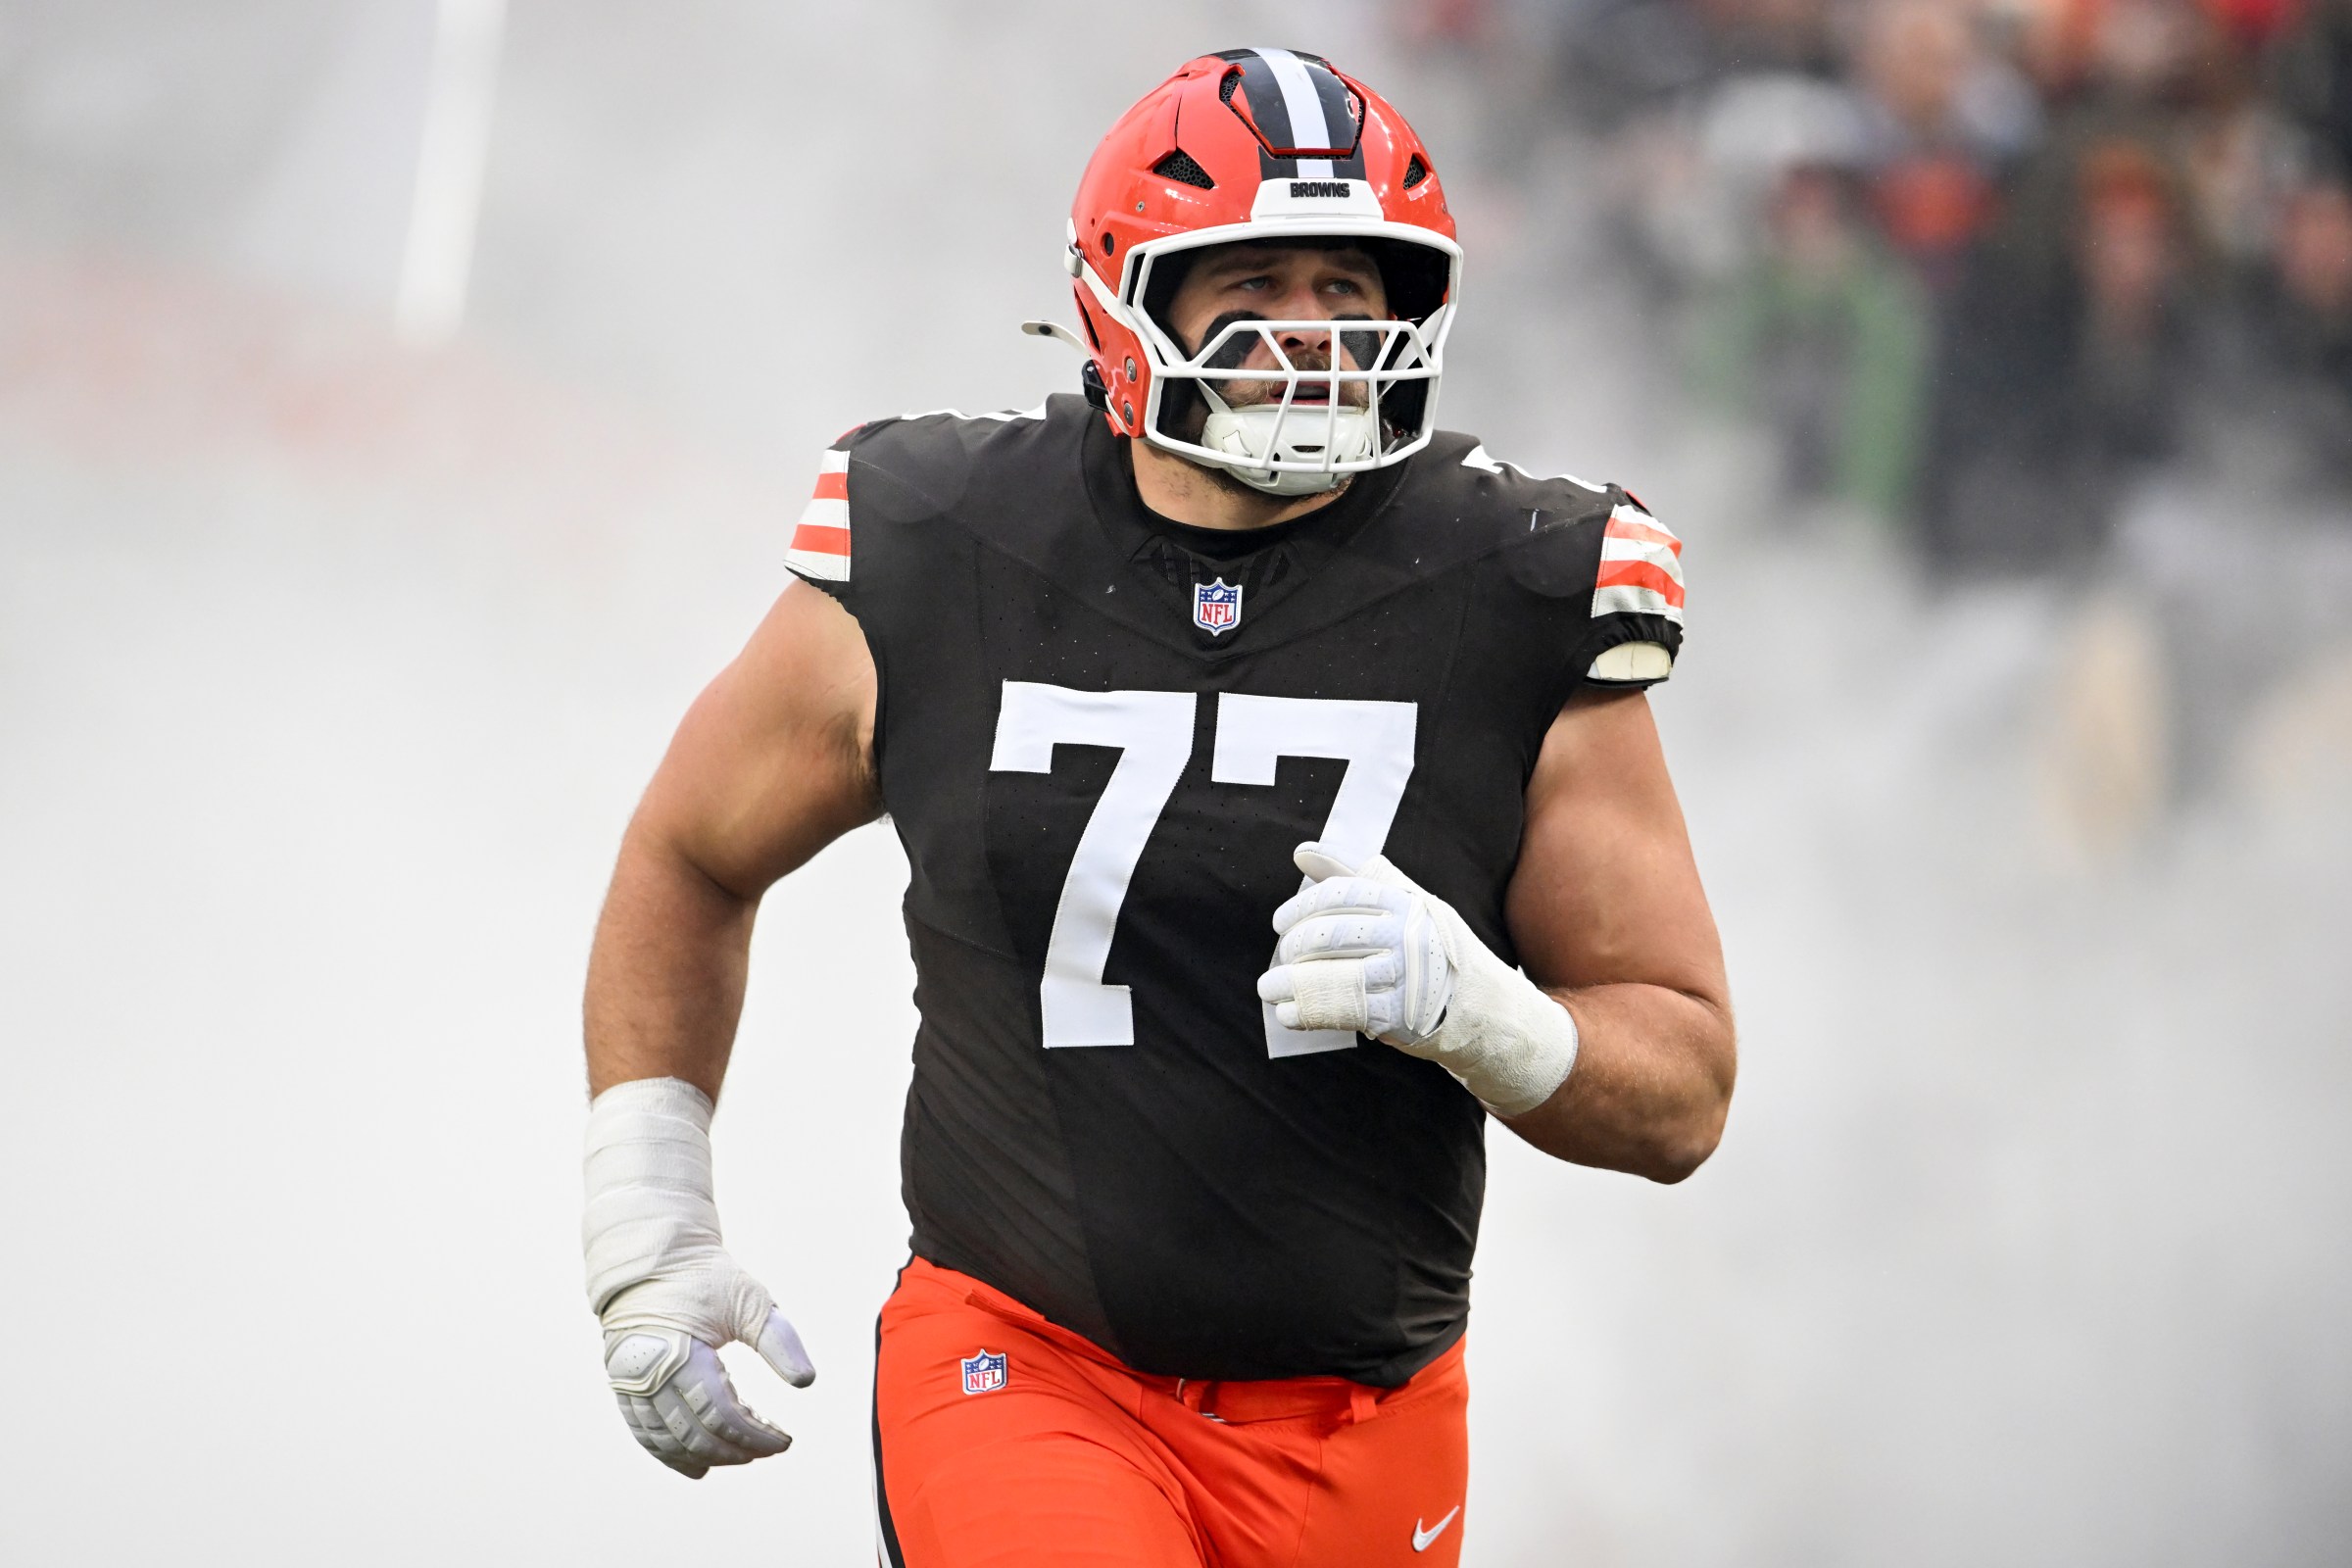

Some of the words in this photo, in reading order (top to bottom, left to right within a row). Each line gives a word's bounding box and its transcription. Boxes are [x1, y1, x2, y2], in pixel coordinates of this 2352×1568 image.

[1290, 182, 1349, 198] BROWNS
[1201, 603, 1233, 625] NFL
[989, 679, 1418, 1059] 77
[968, 1370, 1001, 1389] NFL
